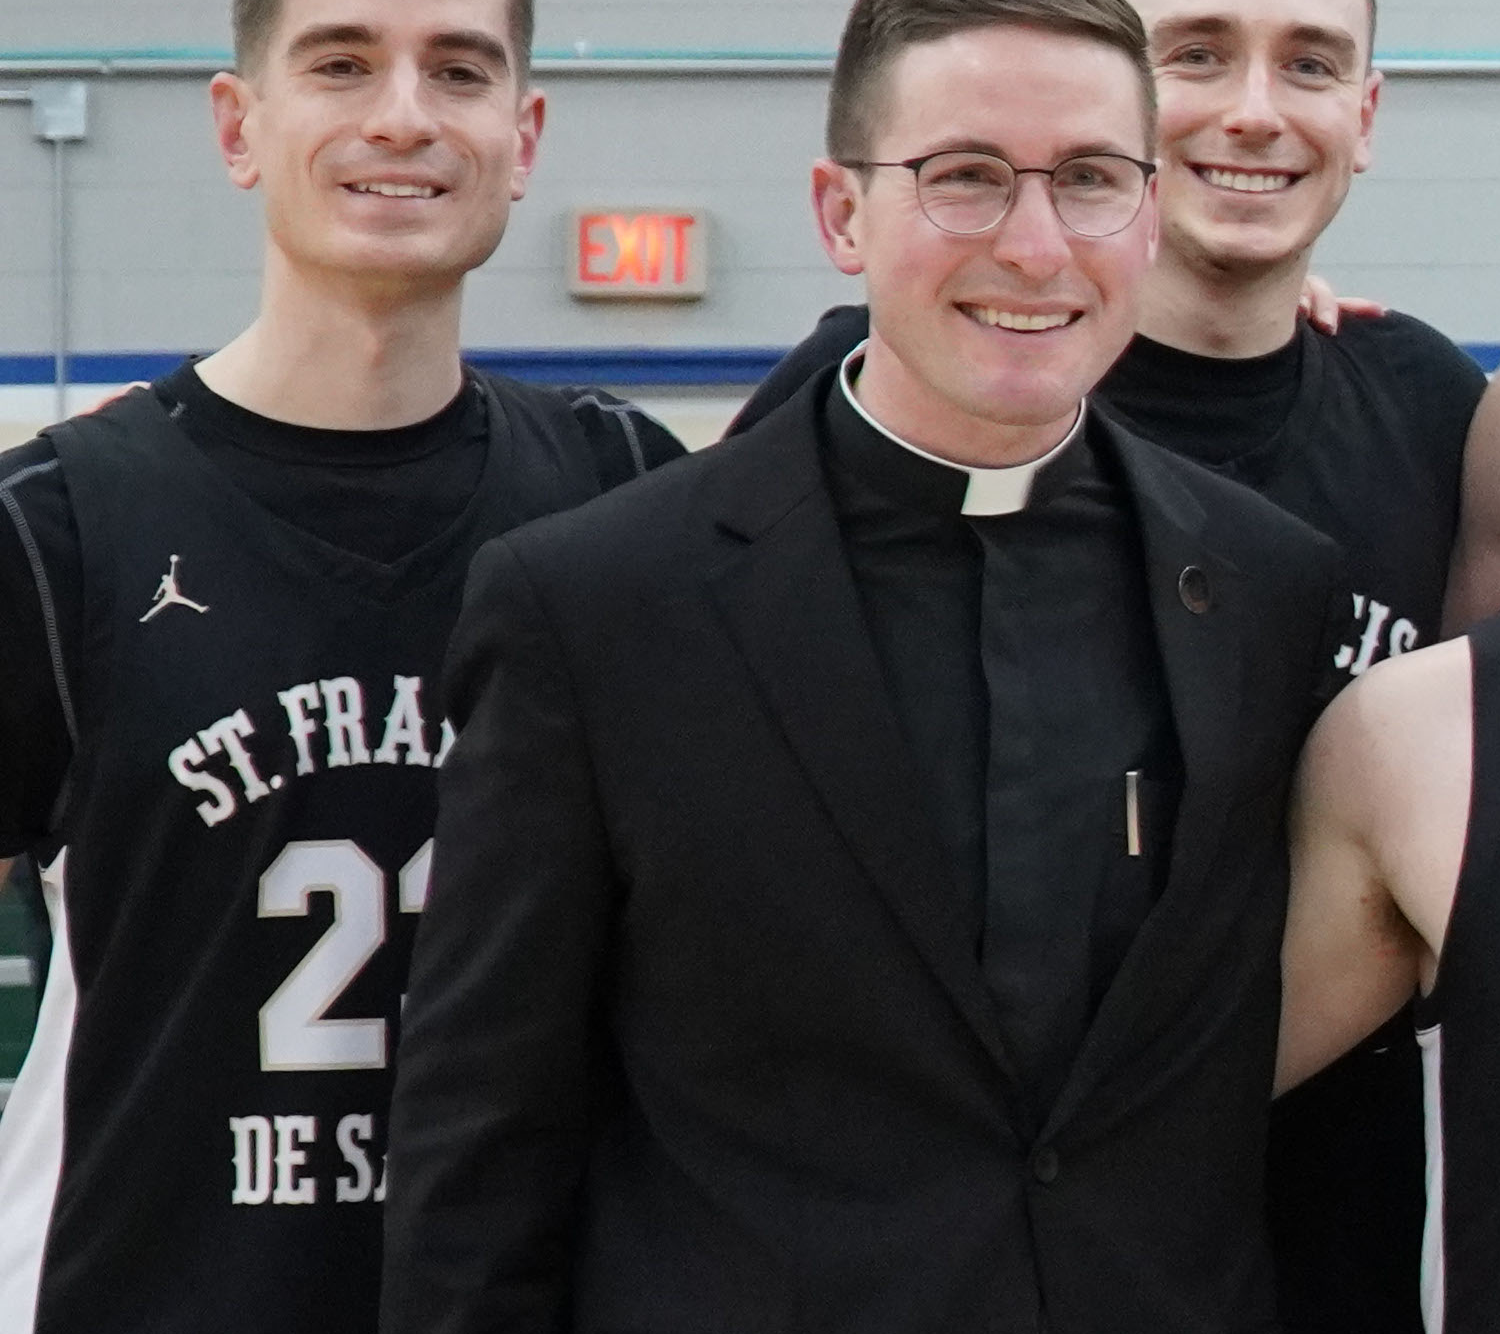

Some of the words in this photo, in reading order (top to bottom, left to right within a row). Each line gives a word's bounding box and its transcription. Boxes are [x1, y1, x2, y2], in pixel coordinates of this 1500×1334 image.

[579, 214, 695, 284] EXIT
[169, 709, 284, 827] ST.
[278, 675, 456, 776] FRA
[257, 837, 435, 1072] 2
[230, 1115, 317, 1205] DE
